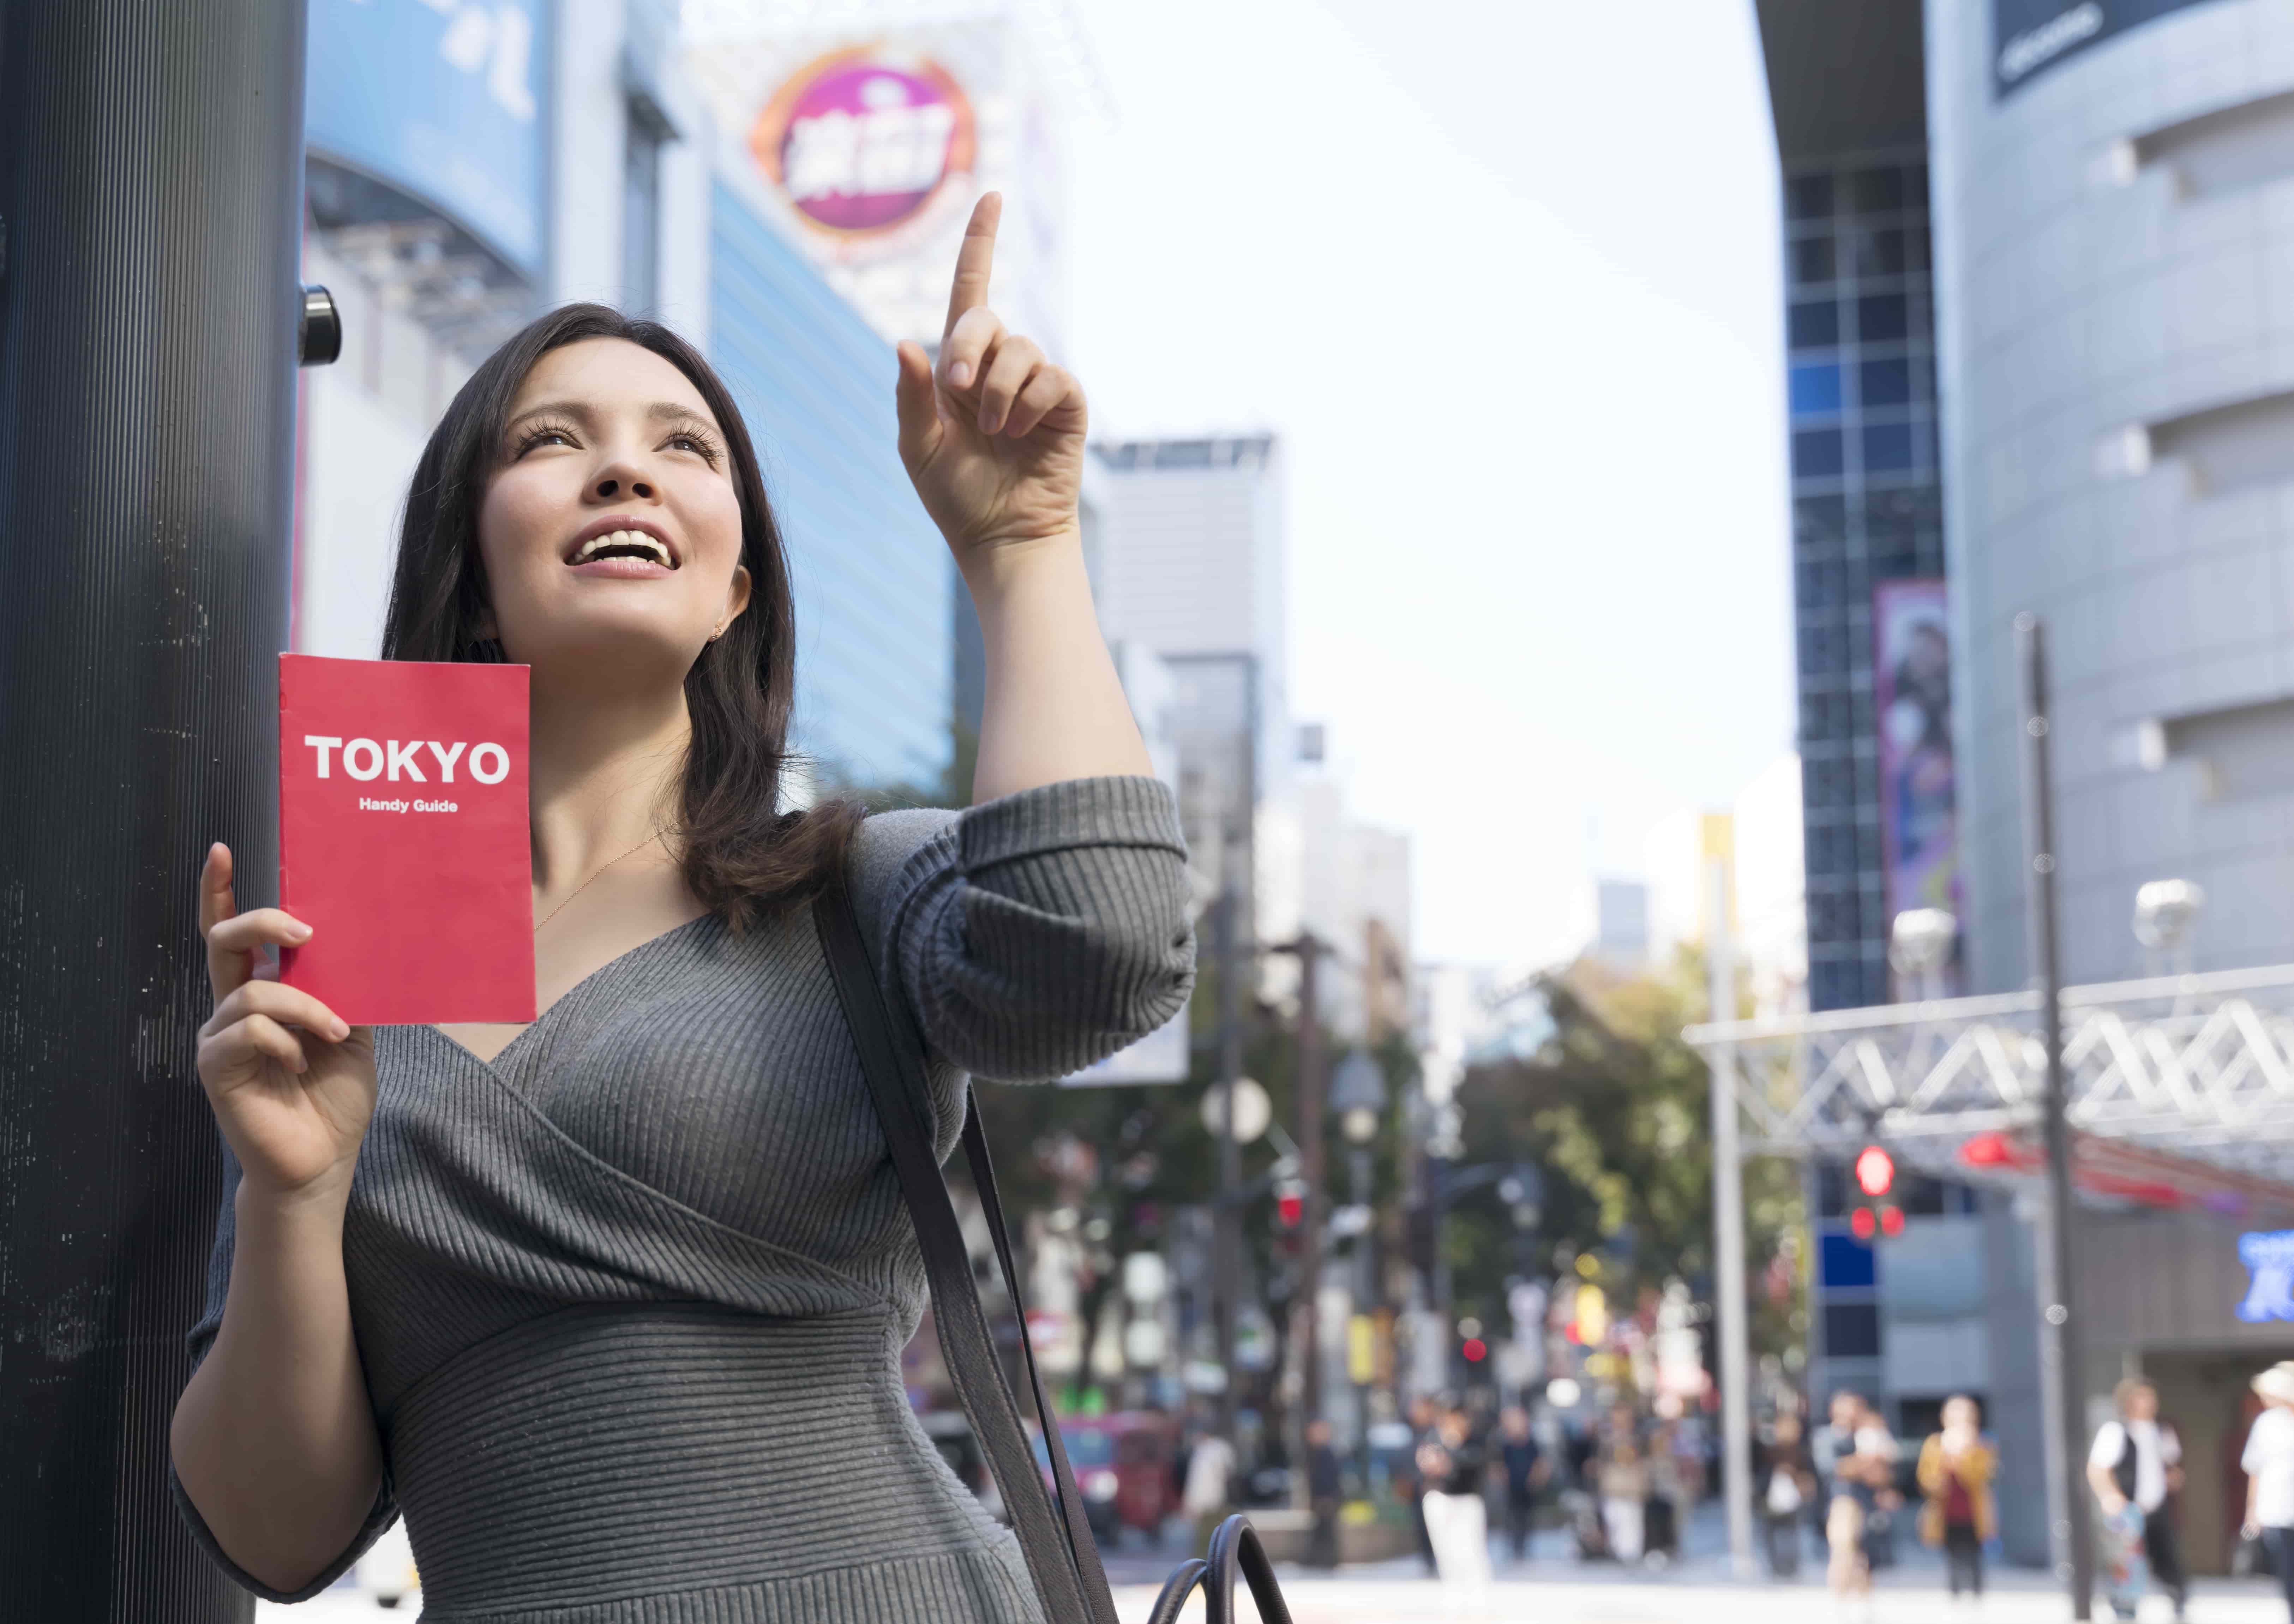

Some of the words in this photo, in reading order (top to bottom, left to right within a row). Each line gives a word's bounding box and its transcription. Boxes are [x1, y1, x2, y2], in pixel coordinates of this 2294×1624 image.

[305, 735, 510, 784] TOKYO
[359, 798, 409, 813] Handy
[413, 799, 458, 812] Guide
